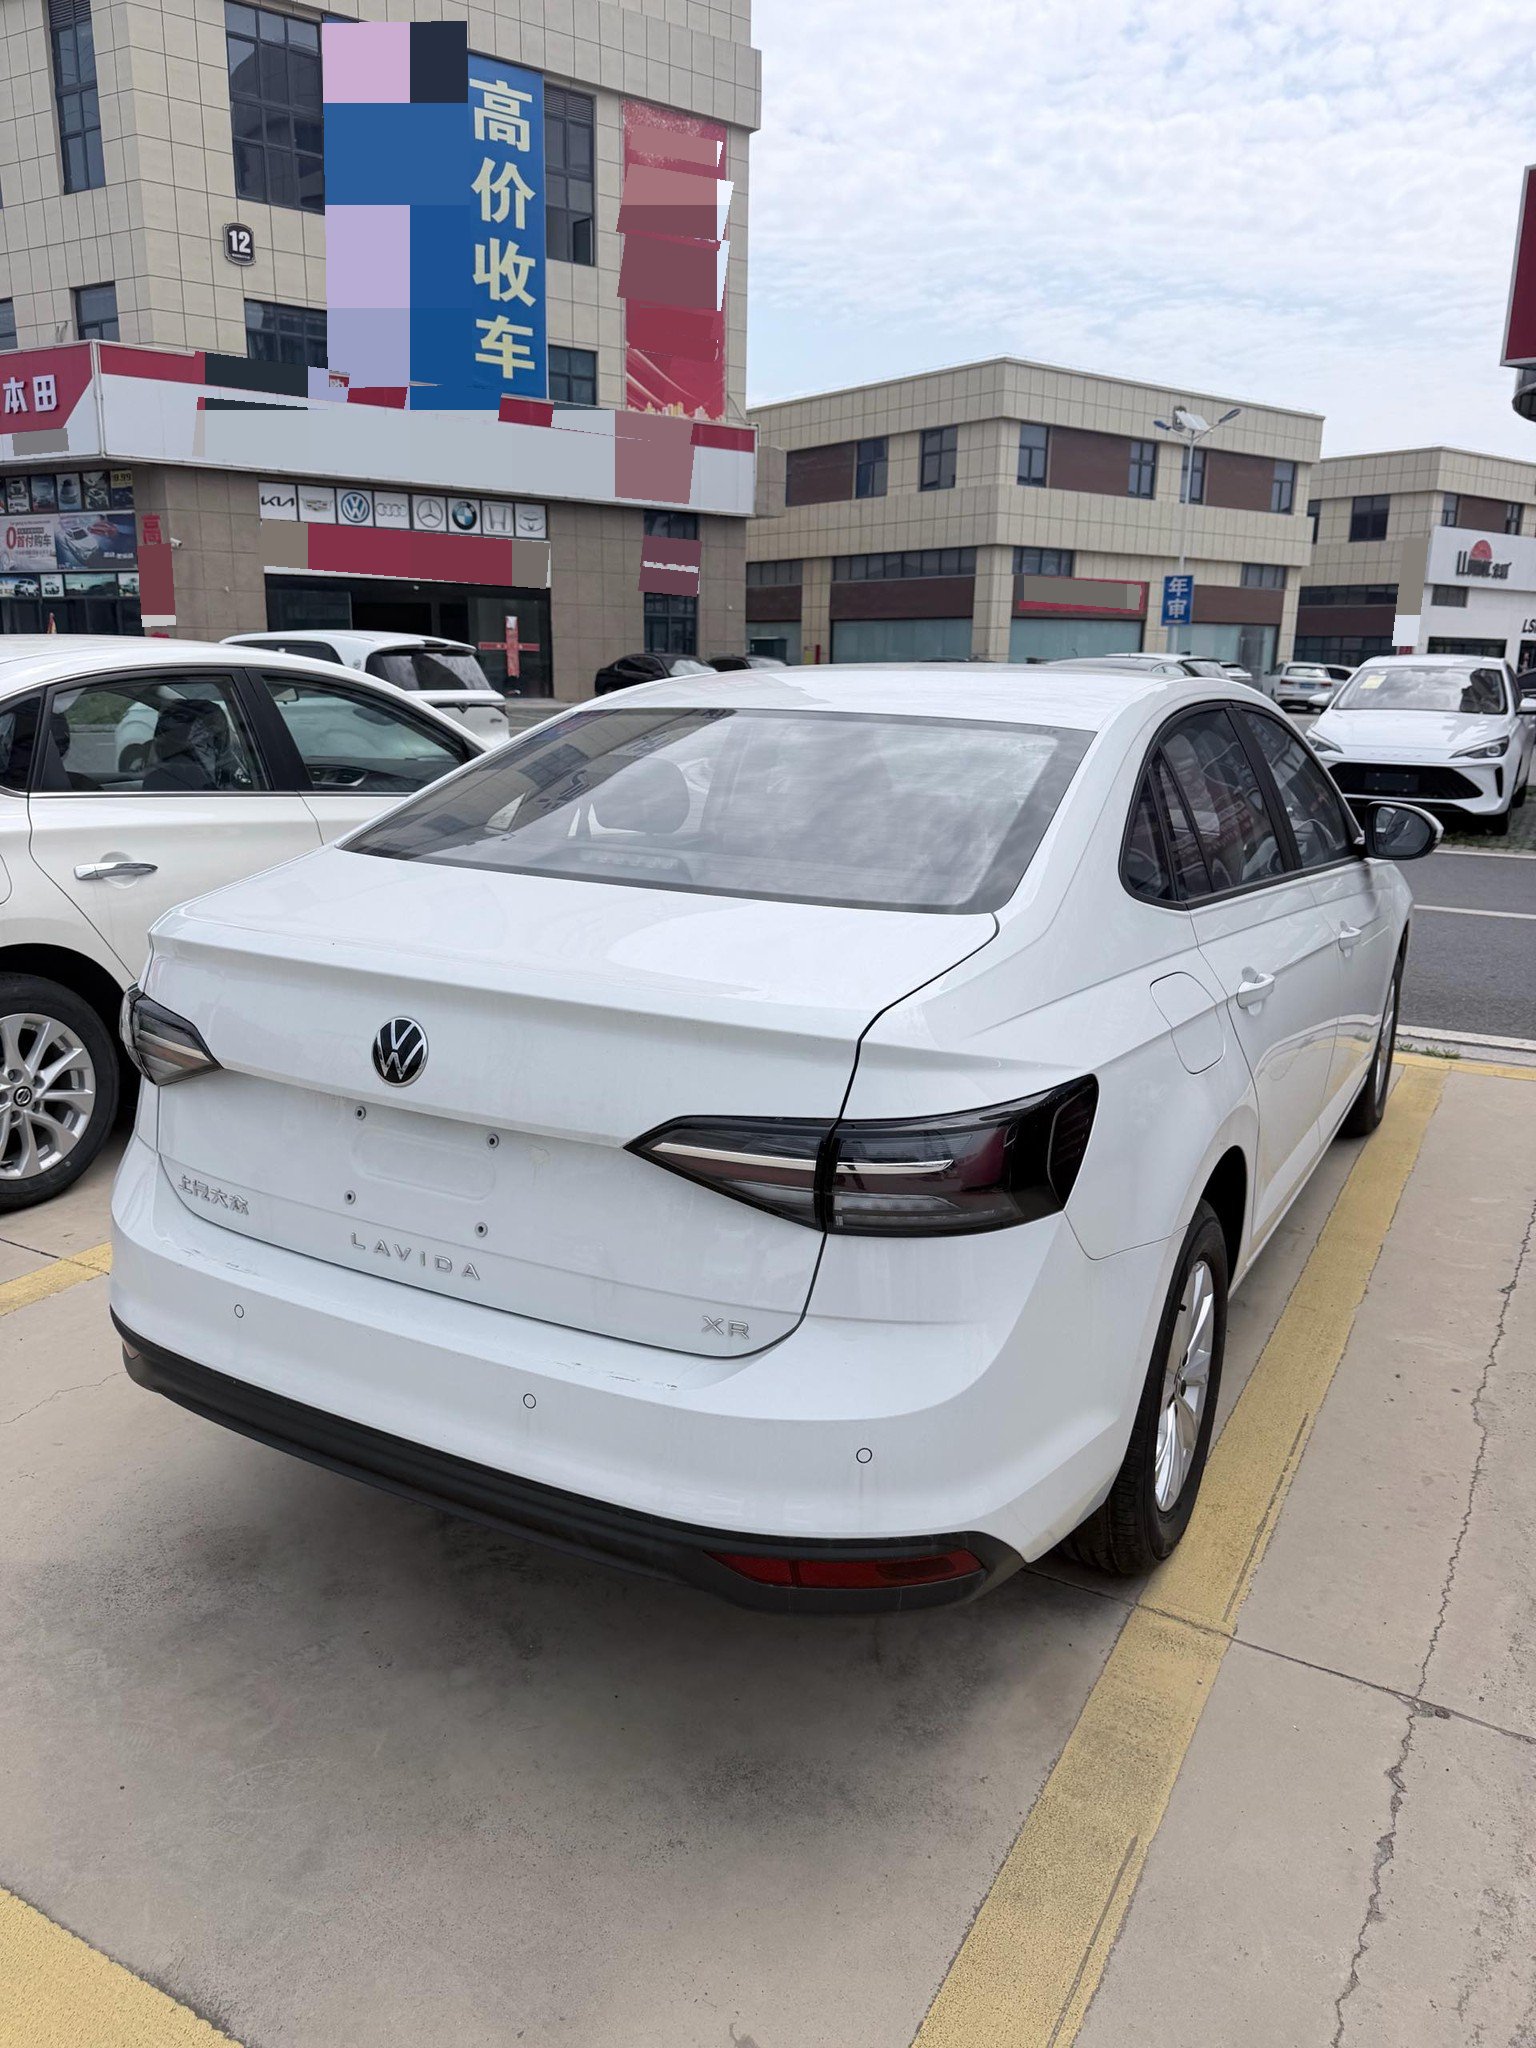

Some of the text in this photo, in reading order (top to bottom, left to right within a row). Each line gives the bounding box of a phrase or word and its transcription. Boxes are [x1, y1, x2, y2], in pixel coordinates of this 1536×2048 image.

[229, 230, 251, 254] 12
[469, 79, 536, 379] 高价收车
[2, 374, 58, 415] 本田
[1168, 577, 1188, 619] 年审
[178, 1174, 249, 1216] 上汽大众
[350, 1232, 480, 1281] LAVIDA
[701, 1314, 750, 1341] XR
